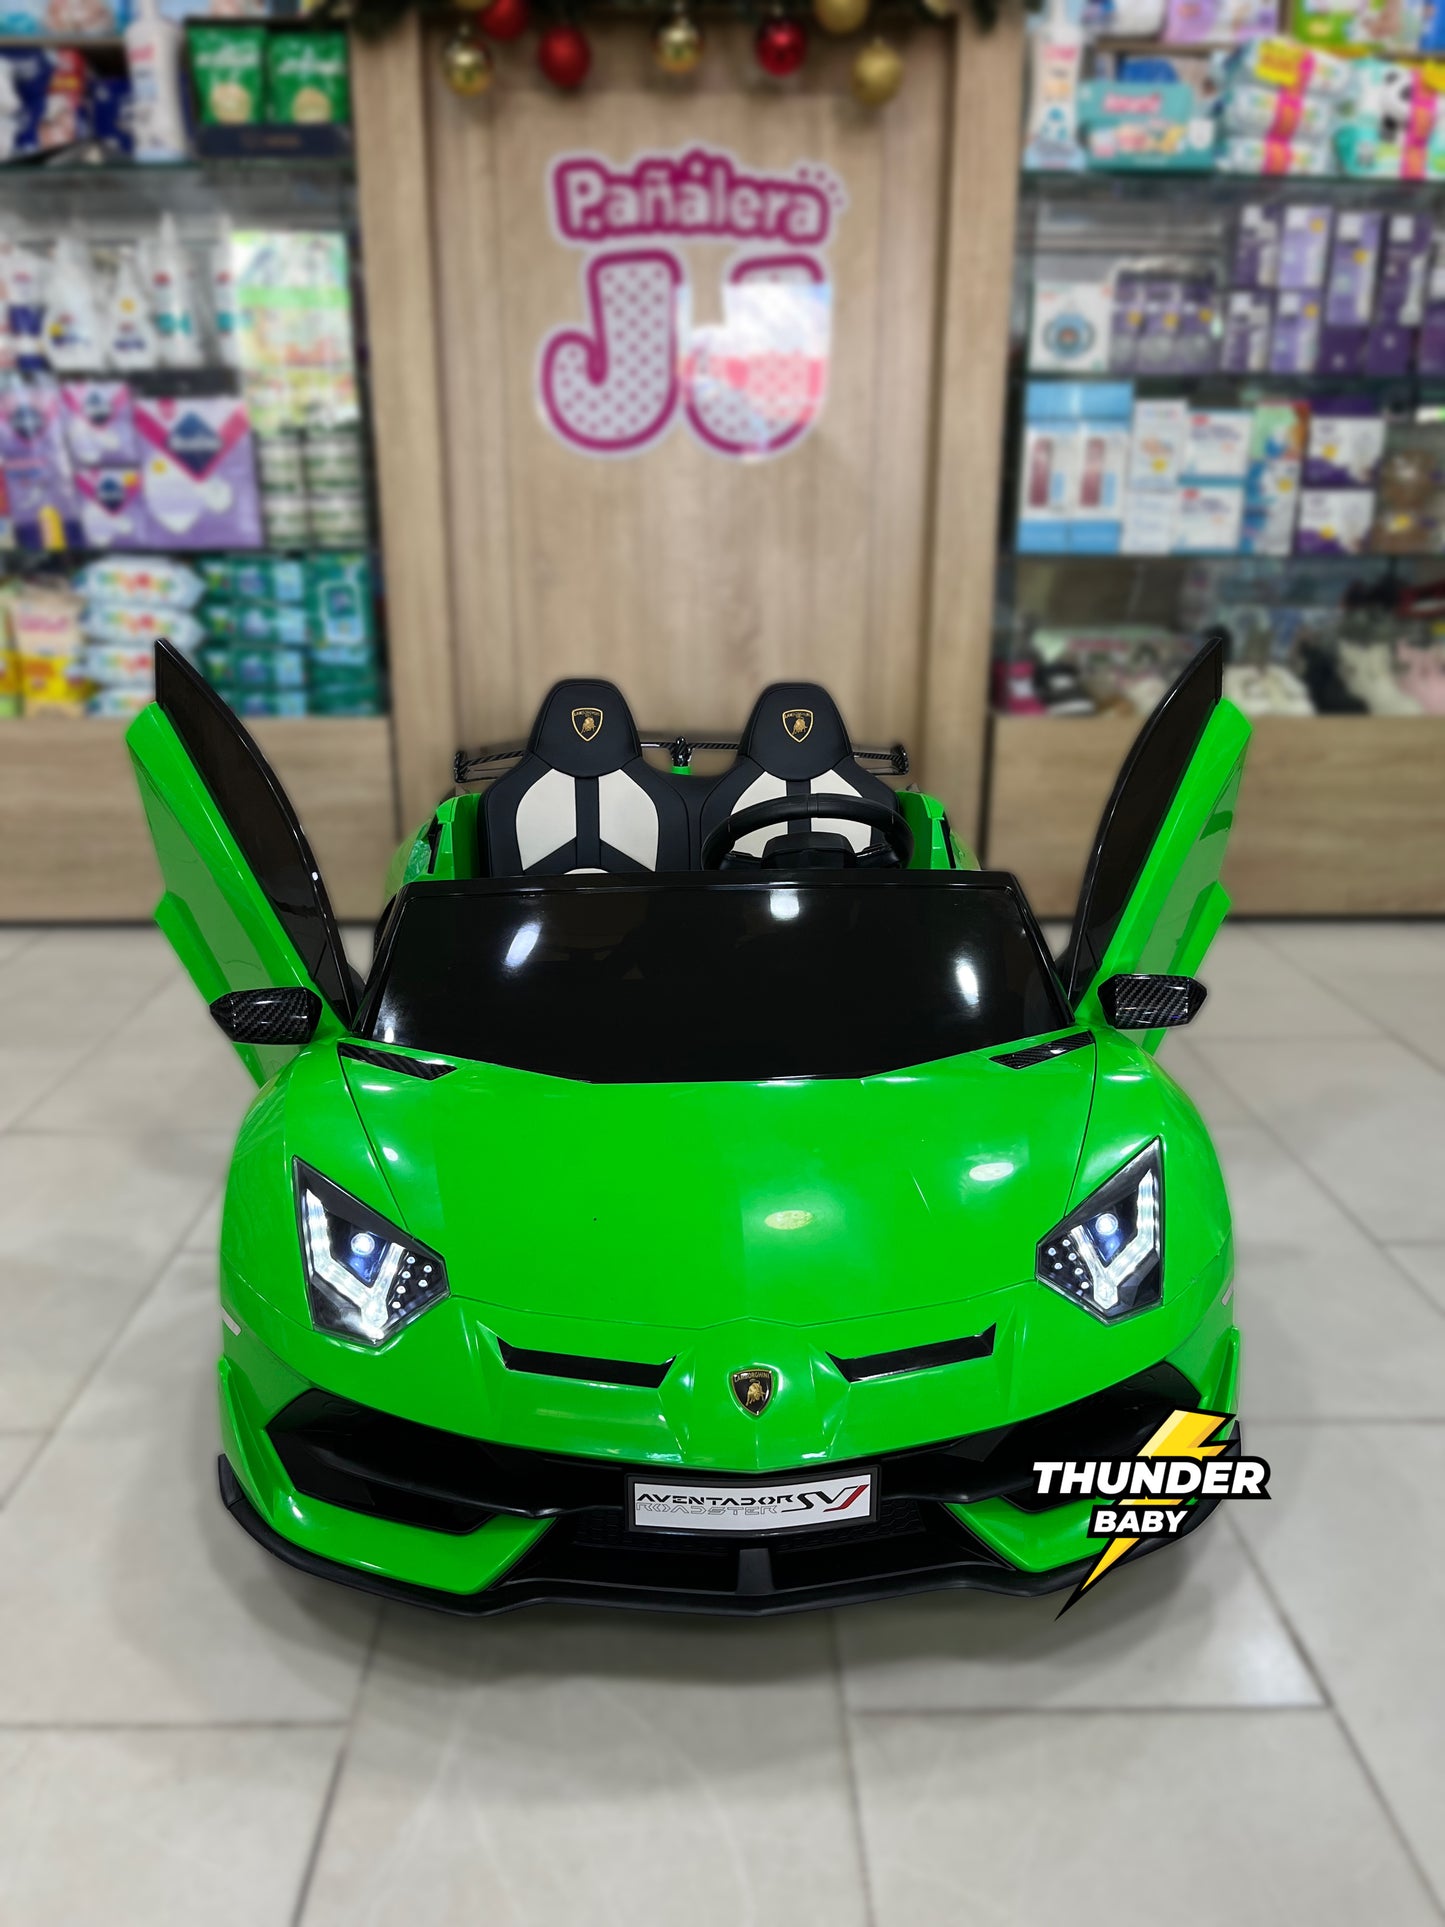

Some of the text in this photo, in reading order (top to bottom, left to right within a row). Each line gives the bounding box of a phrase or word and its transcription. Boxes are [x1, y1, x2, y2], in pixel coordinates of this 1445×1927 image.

[560, 159, 824, 238] Pañalera
[636, 1484, 869, 1512] AVENTADOR SVJ
[636, 1502, 777, 1515] ROADSTER
